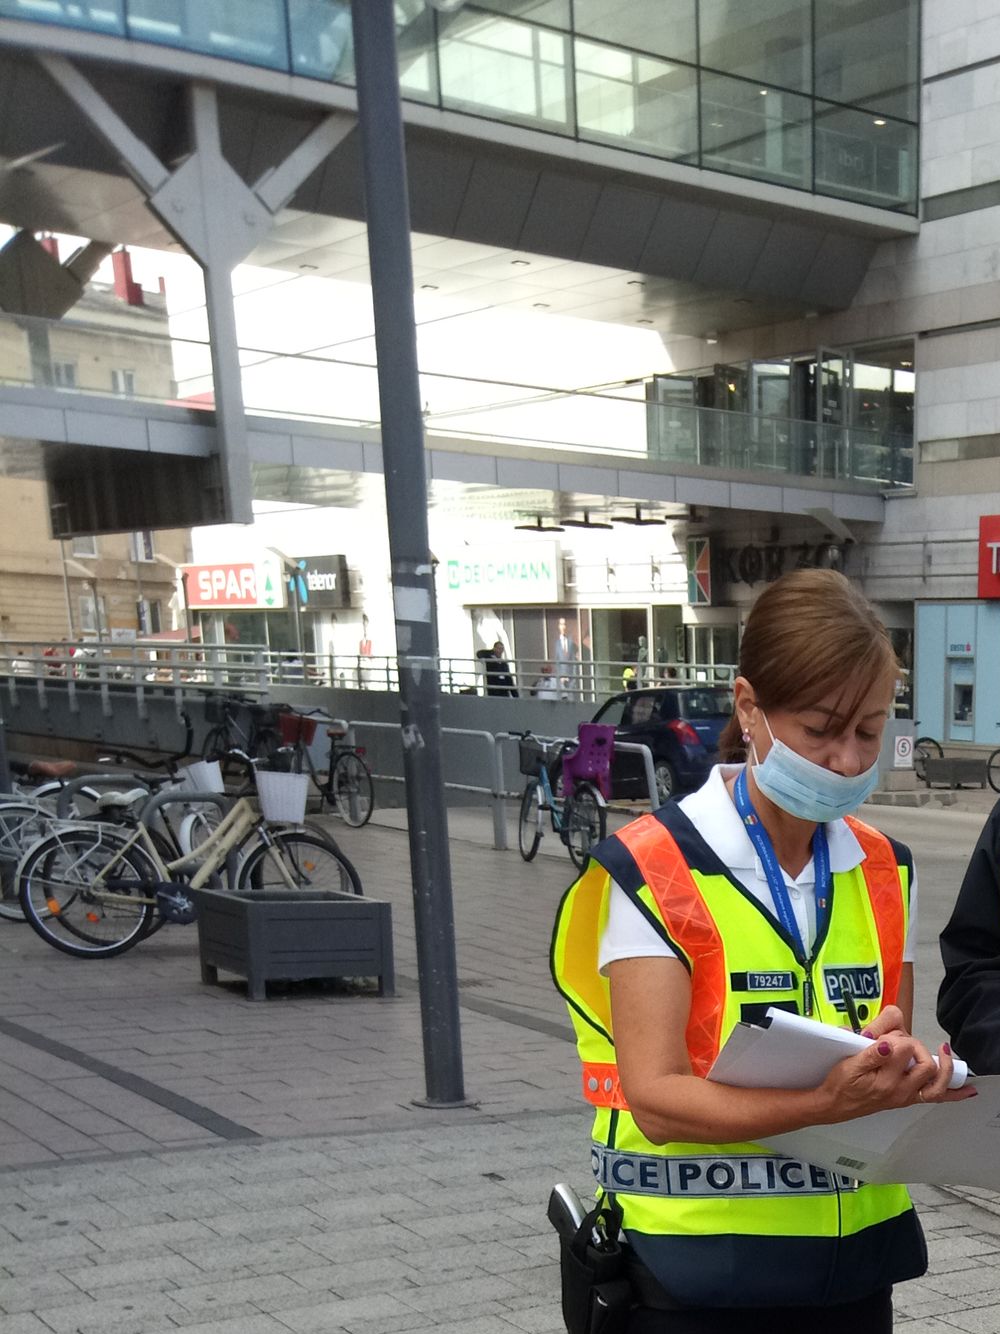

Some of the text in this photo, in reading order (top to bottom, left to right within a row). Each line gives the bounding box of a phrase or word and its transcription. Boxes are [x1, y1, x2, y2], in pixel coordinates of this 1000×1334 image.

[306, 569, 337, 591] telenor
[464, 561, 551, 583] DEICHMANN
[197, 568, 257, 600] SPAR
[901, 742, 907, 754] 5
[754, 975, 784, 987] 79247
[592, 1150, 830, 1191] ICE POLICE
